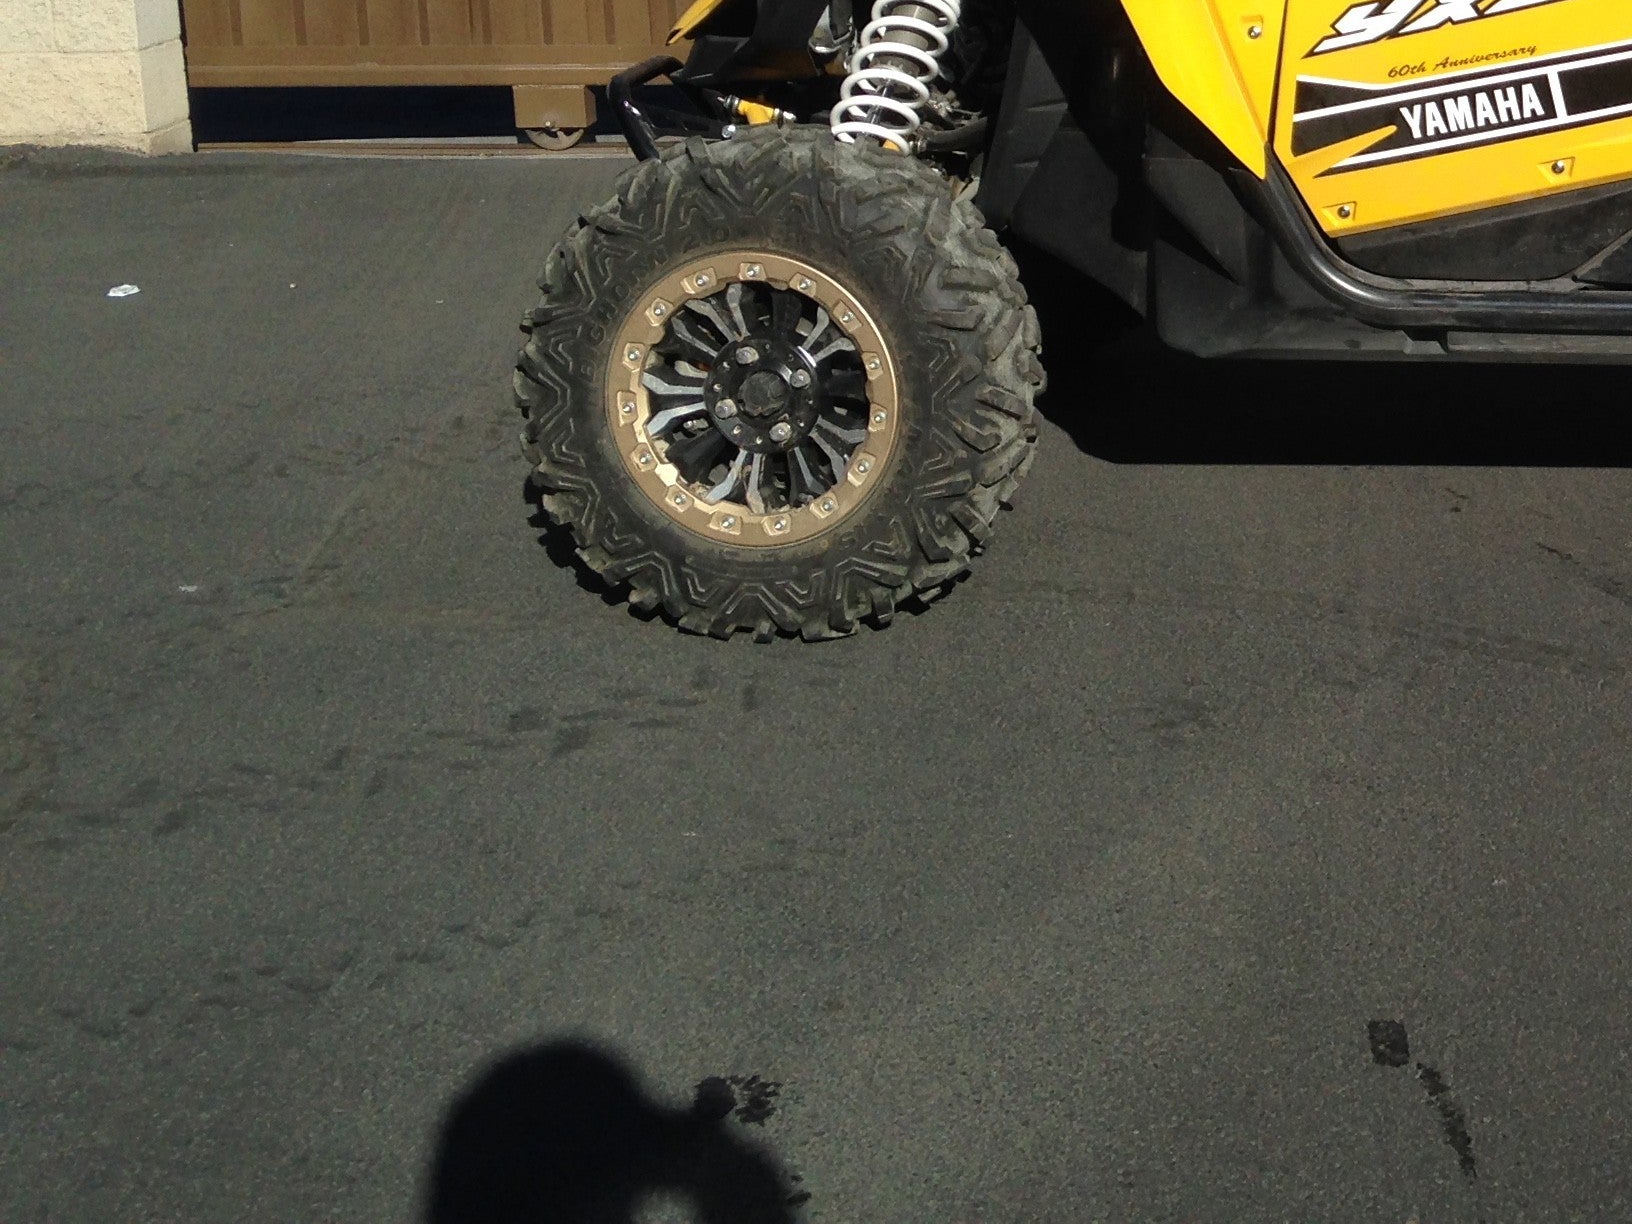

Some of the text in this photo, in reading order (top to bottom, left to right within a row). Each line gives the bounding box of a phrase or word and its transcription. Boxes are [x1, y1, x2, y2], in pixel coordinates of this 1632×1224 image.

[1387, 44, 1537, 78] 60th Anniversary
[1400, 83, 1545, 139] YAMAHA
